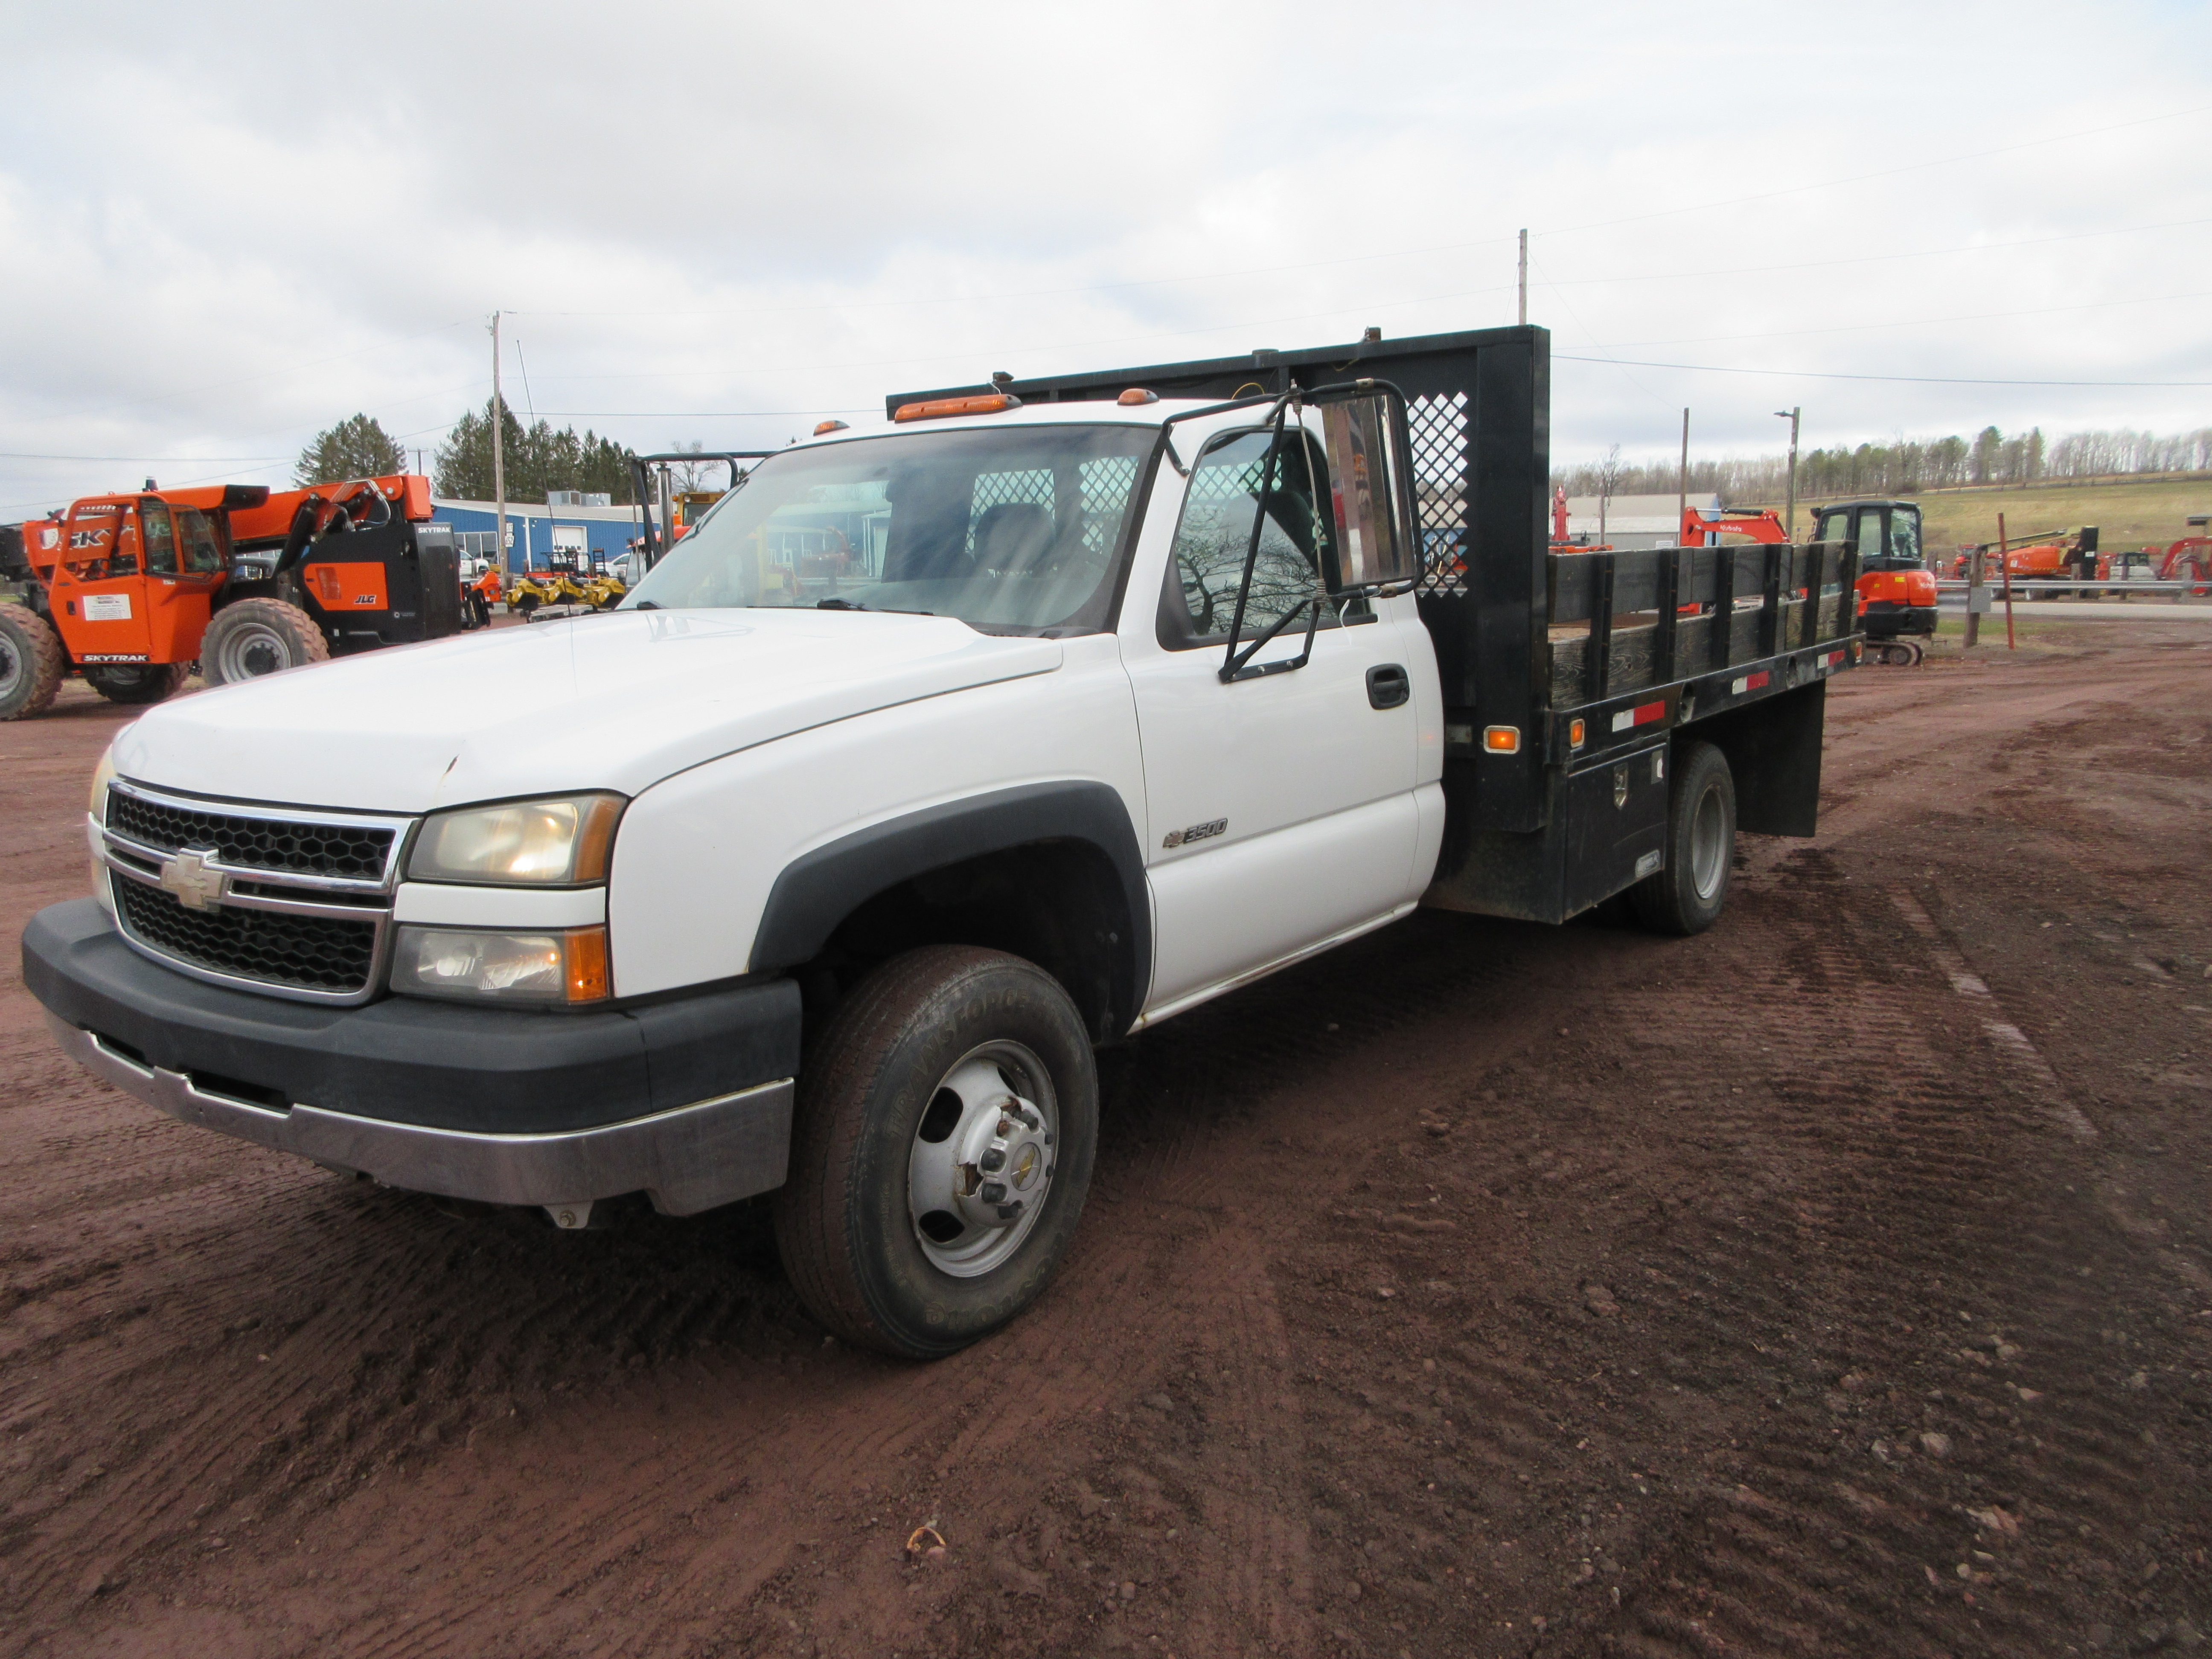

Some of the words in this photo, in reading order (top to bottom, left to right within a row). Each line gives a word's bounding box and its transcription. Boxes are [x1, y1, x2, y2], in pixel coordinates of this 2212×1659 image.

[354, 595, 376, 604] JLG
[1186, 818, 1228, 843] 3500
[882, 984, 1032, 1138] TRANSFORCE
